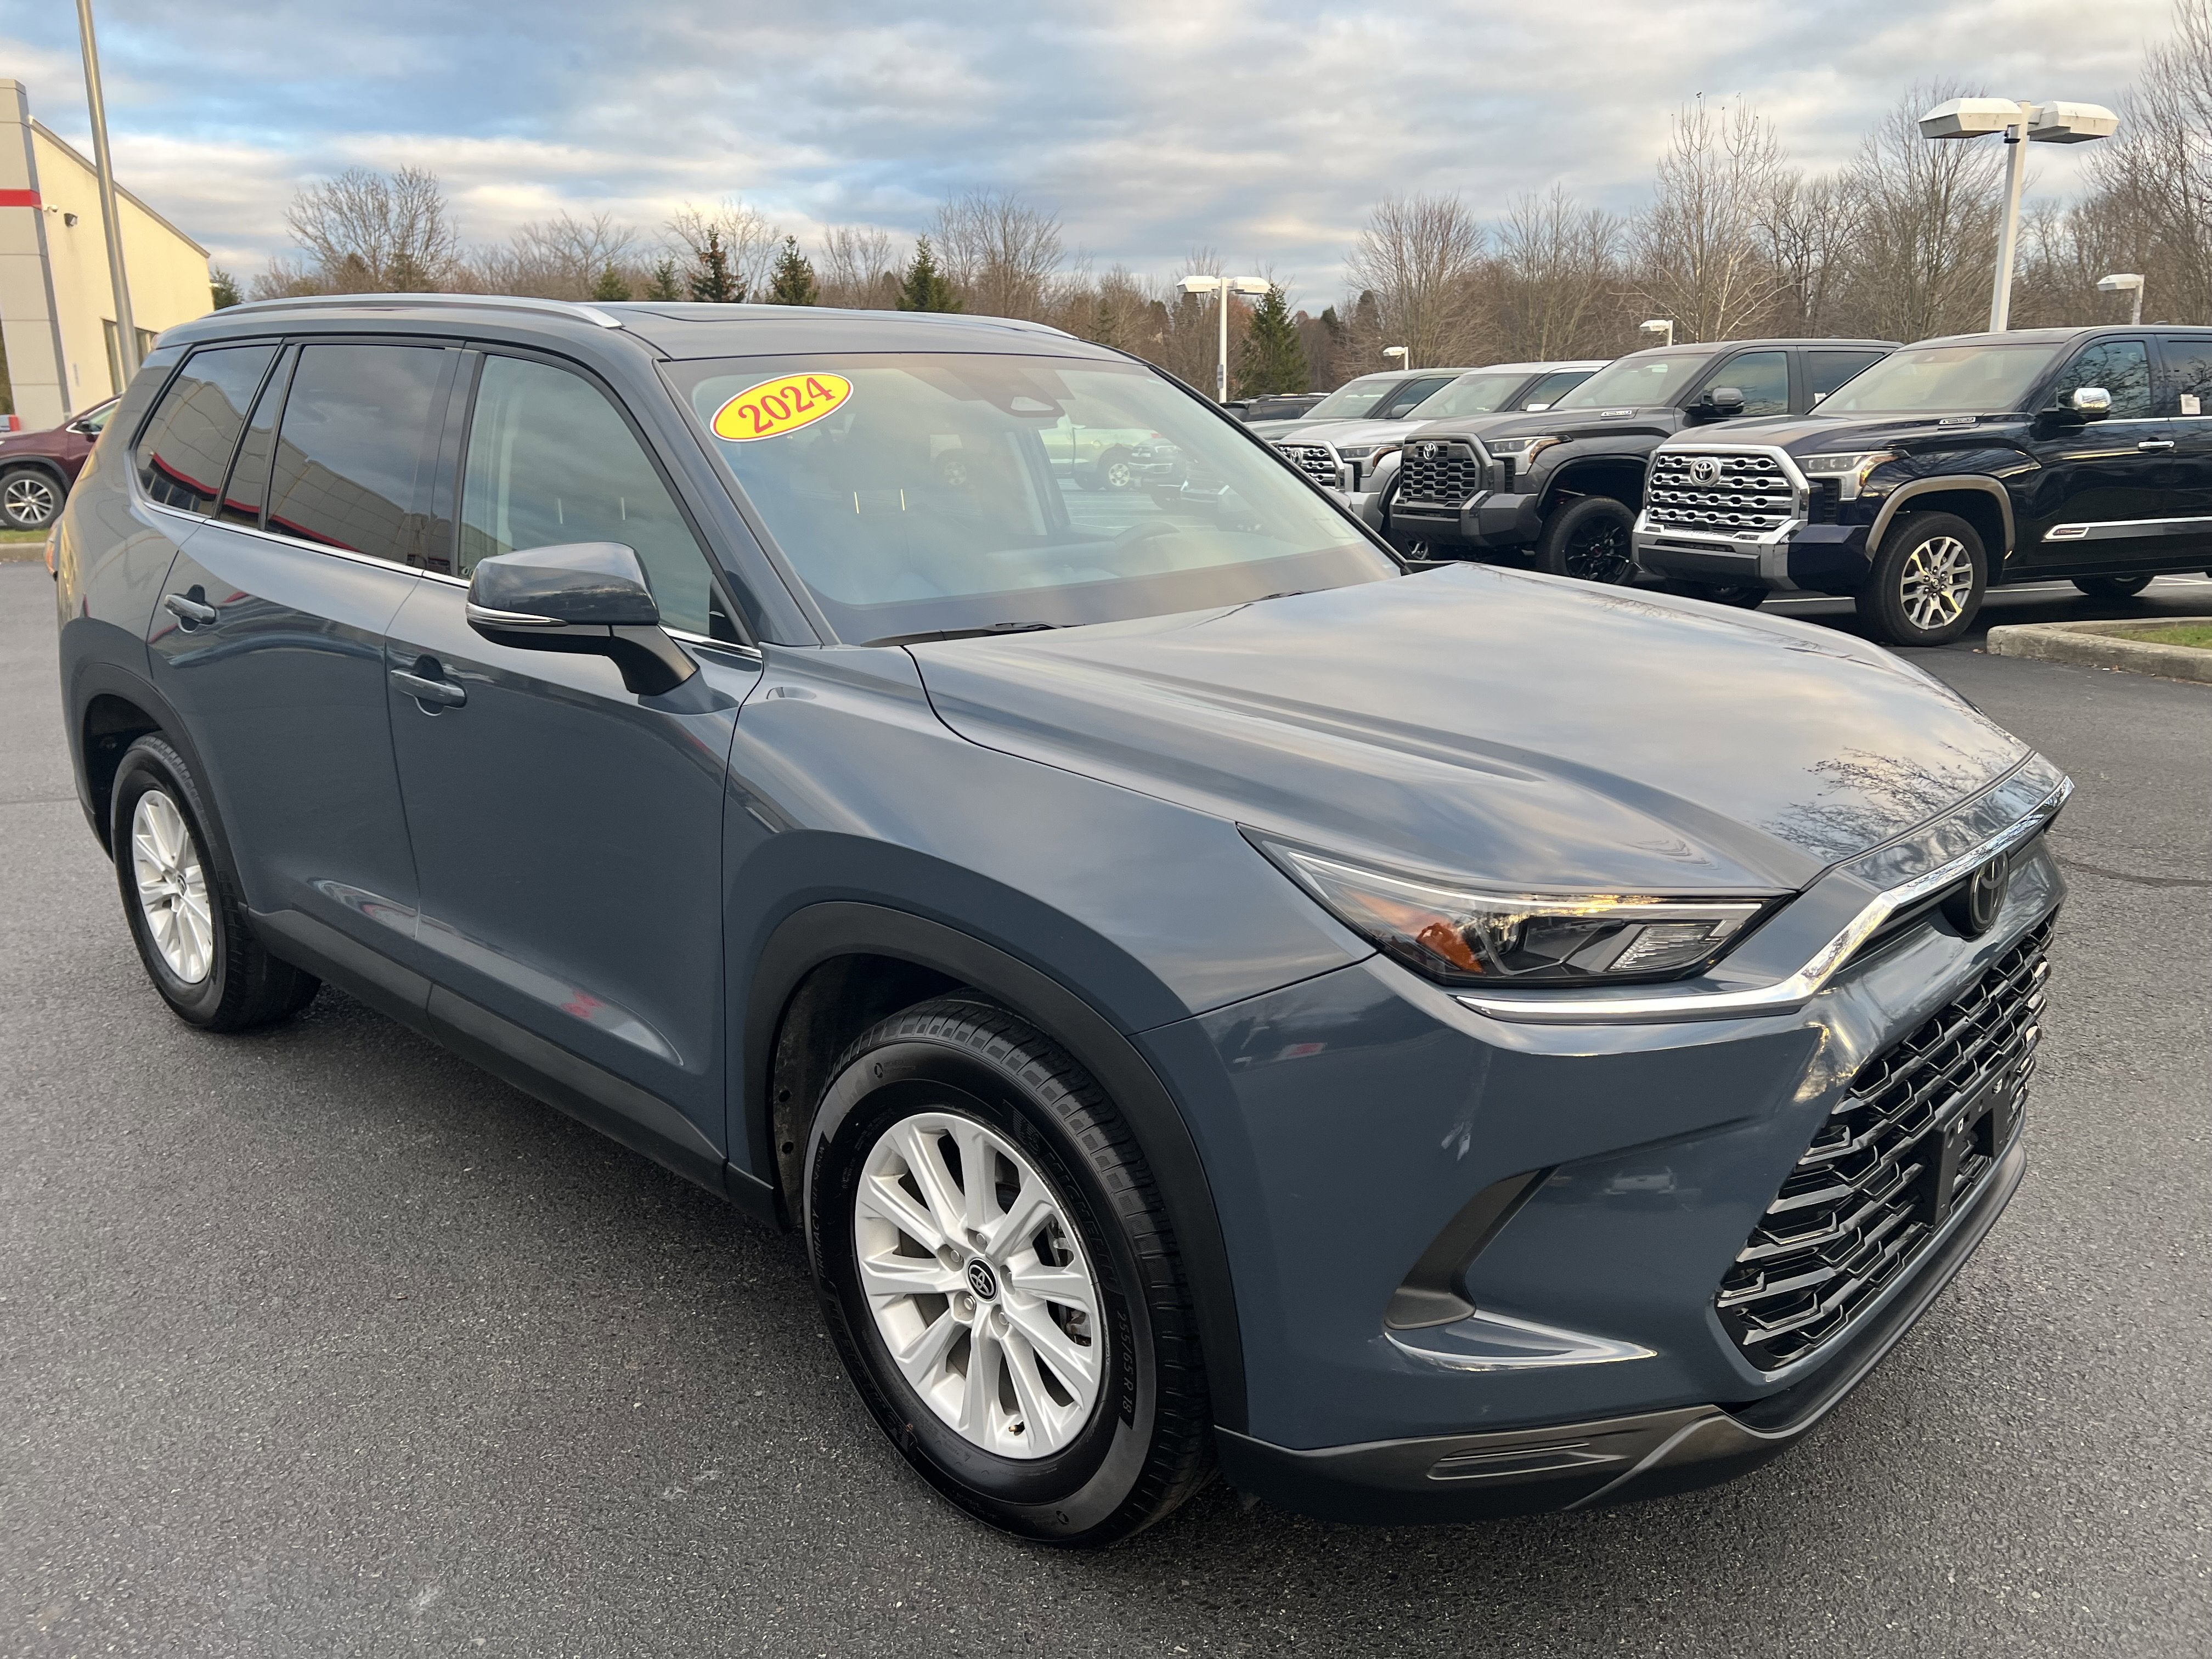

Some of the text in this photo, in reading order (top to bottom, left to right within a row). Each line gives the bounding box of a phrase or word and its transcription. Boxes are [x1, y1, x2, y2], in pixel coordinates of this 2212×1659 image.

[738, 376, 836, 434] 2024
[811, 1210, 826, 1278] PRIMACY
[1117, 1310, 1134, 1414] 255/65 R 18
